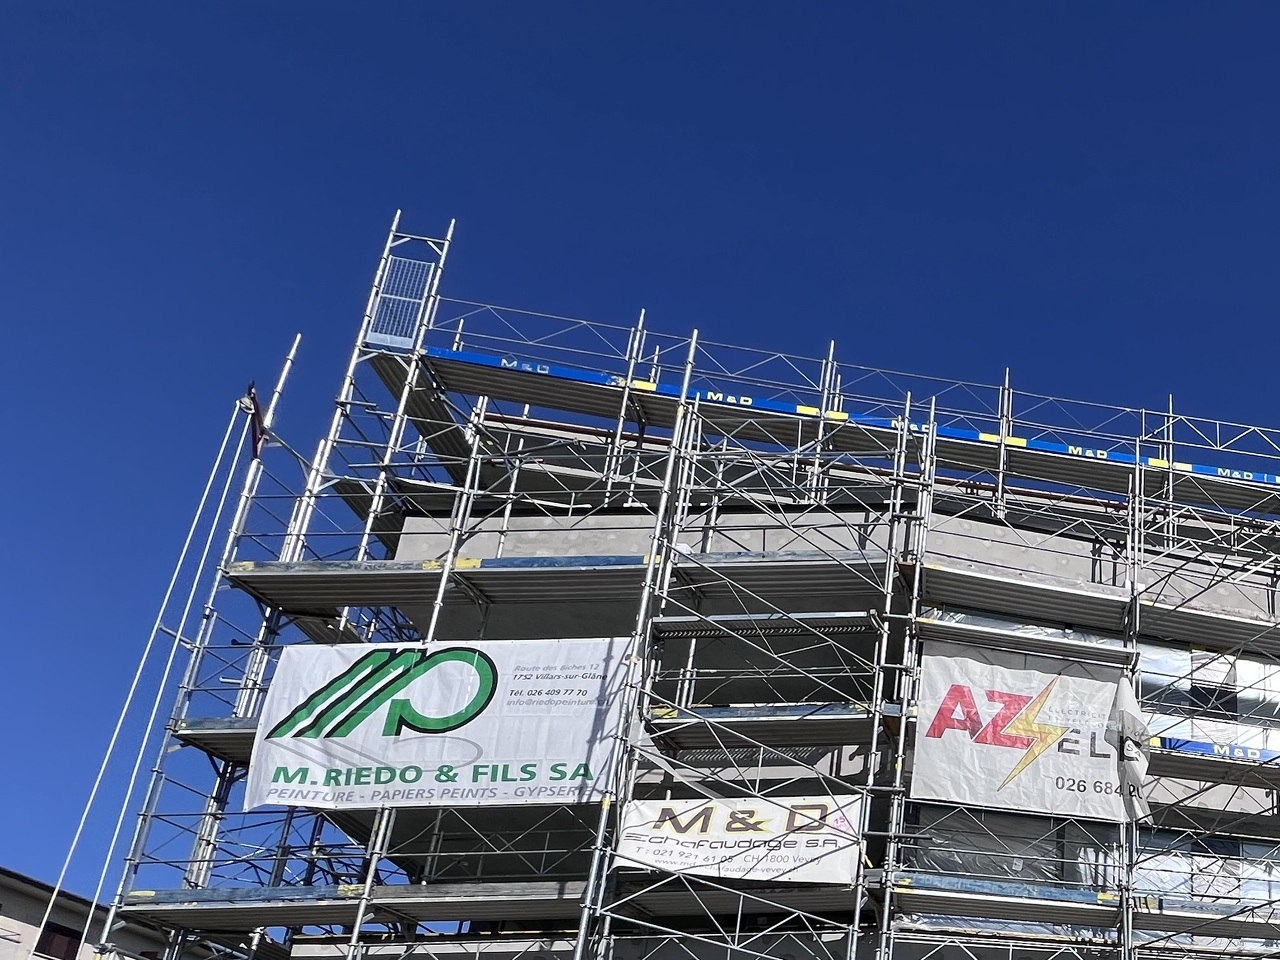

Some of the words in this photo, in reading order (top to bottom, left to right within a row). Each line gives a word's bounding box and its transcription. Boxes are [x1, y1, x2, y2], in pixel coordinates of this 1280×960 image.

[562, 688, 575, 696] 77
[925, 684, 1034, 750] AZ
[323, 765, 423, 787] RIEDO
[434, 764, 459, 783] &
[472, 763, 538, 783] FILS
[549, 763, 594, 781] SA
[1055, 776, 1087, 793] 026
[266, 788, 355, 802] PEINTURE
[370, 788, 436, 801] PAPIERS
[440, 787, 498, 799] PEINTS
[653, 849, 674, 857] 021
[678, 851, 699, 860] 921
[720, 855, 734, 863] 05
[743, 854, 761, 863] CH
[765, 854, 790, 863] 1800
[792, 854, 822, 866] Vevey
